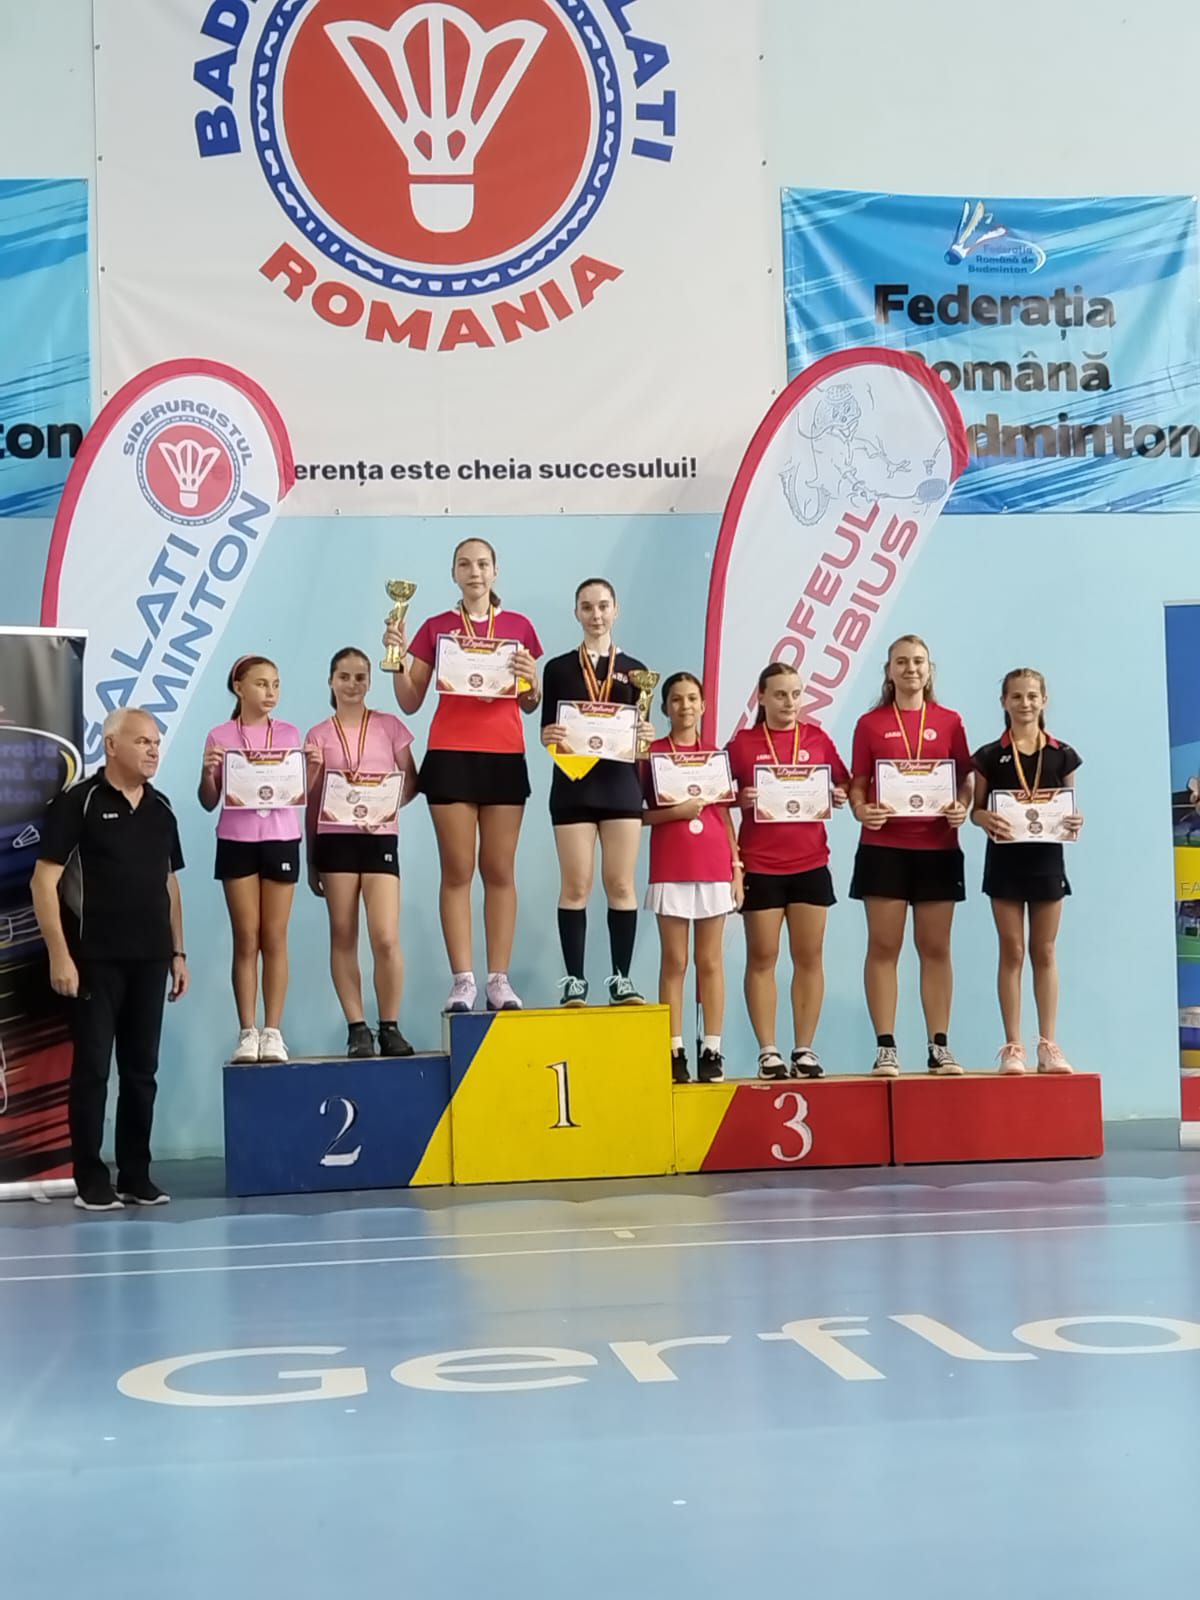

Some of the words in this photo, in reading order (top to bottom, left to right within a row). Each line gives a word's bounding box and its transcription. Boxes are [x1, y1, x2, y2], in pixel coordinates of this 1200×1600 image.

[193, 0, 257, 158] BAD
[258, 241, 625, 352] ROMANIA
[874, 284, 1116, 341] Federația
[905, 350, 1113, 392] omână
[123, 399, 253, 467] SIDERURGISTUL
[390, 460, 451, 480] este
[457, 458, 533, 480] cheia
[539, 457, 698, 480] succesului!
[140, 491, 271, 736] MINTON
[545, 1061, 581, 1129] 1
[771, 1091, 813, 1162] 3
[319, 1095, 363, 1167] 2
[117, 1313, 1200, 1408] Gerflo
